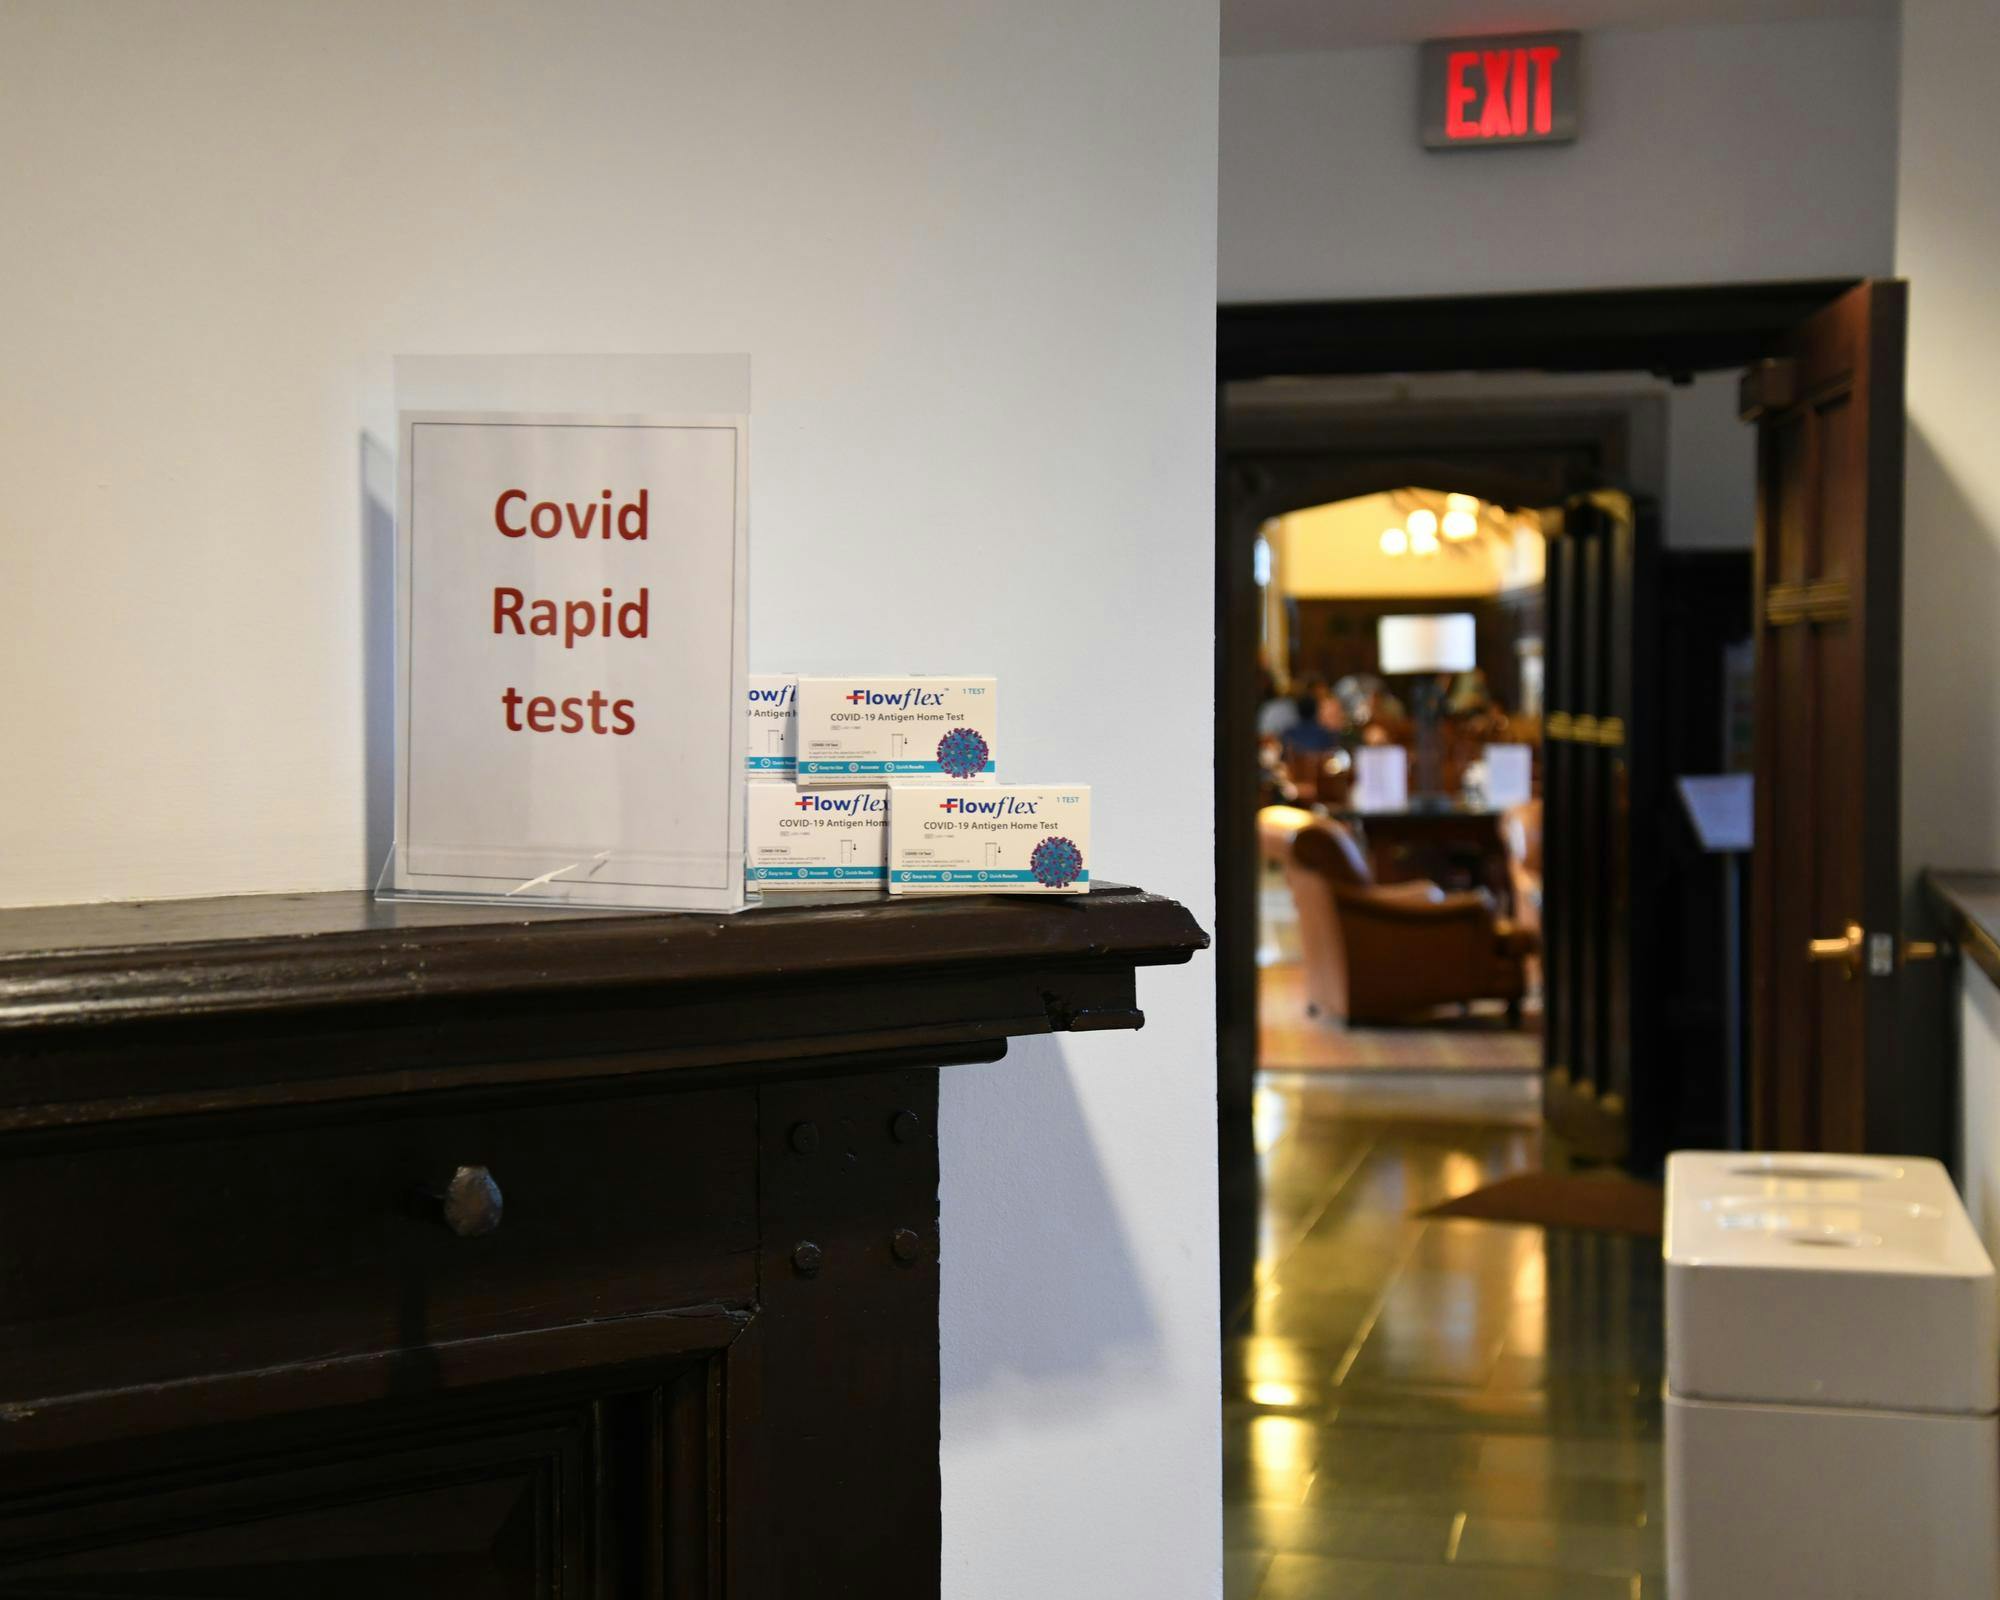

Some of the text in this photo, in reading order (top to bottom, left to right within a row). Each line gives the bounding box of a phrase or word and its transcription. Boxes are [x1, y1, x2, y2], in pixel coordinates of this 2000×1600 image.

[1445, 46, 1561, 140] EXIT
[494, 488, 649, 540] Covid
[492, 586, 649, 649] Rapid
[501, 687, 636, 735] tests
[846, 688, 945, 711] Flowflex
[754, 709, 791, 719] Antigen
[830, 712, 965, 723] COVID-19 Antigen Home Test
[940, 796, 1038, 819] Flowflex
[779, 819, 825, 828] COVID-19
[826, 819, 864, 829] Antigen
[923, 821, 1058, 832] COVID-19 Antigen Home Test
